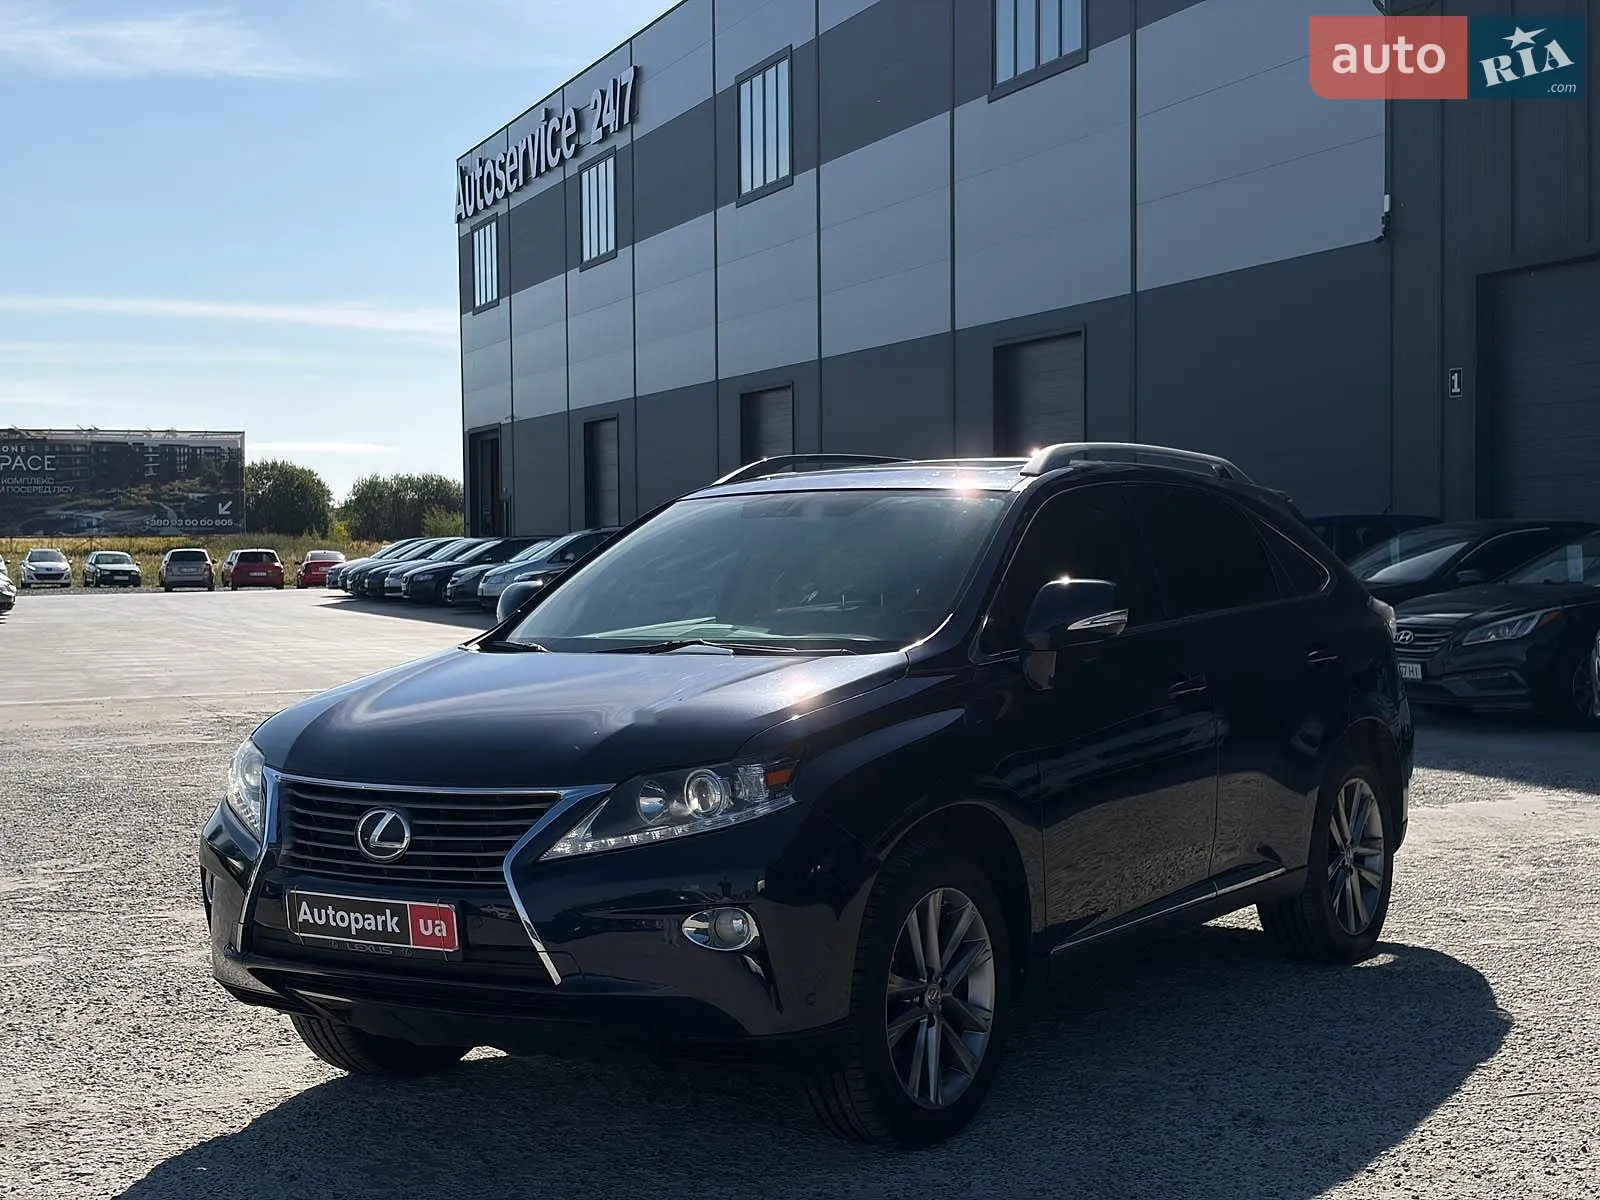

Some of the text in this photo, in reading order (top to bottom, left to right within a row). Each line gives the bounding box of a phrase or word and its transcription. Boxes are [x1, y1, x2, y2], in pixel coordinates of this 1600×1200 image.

[455, 64, 640, 220] Autoservice 24/7
[1451, 372, 1461, 393] 1
[298, 901, 447, 937] Autopark ua
[346, 942, 393, 955] LEXUS
